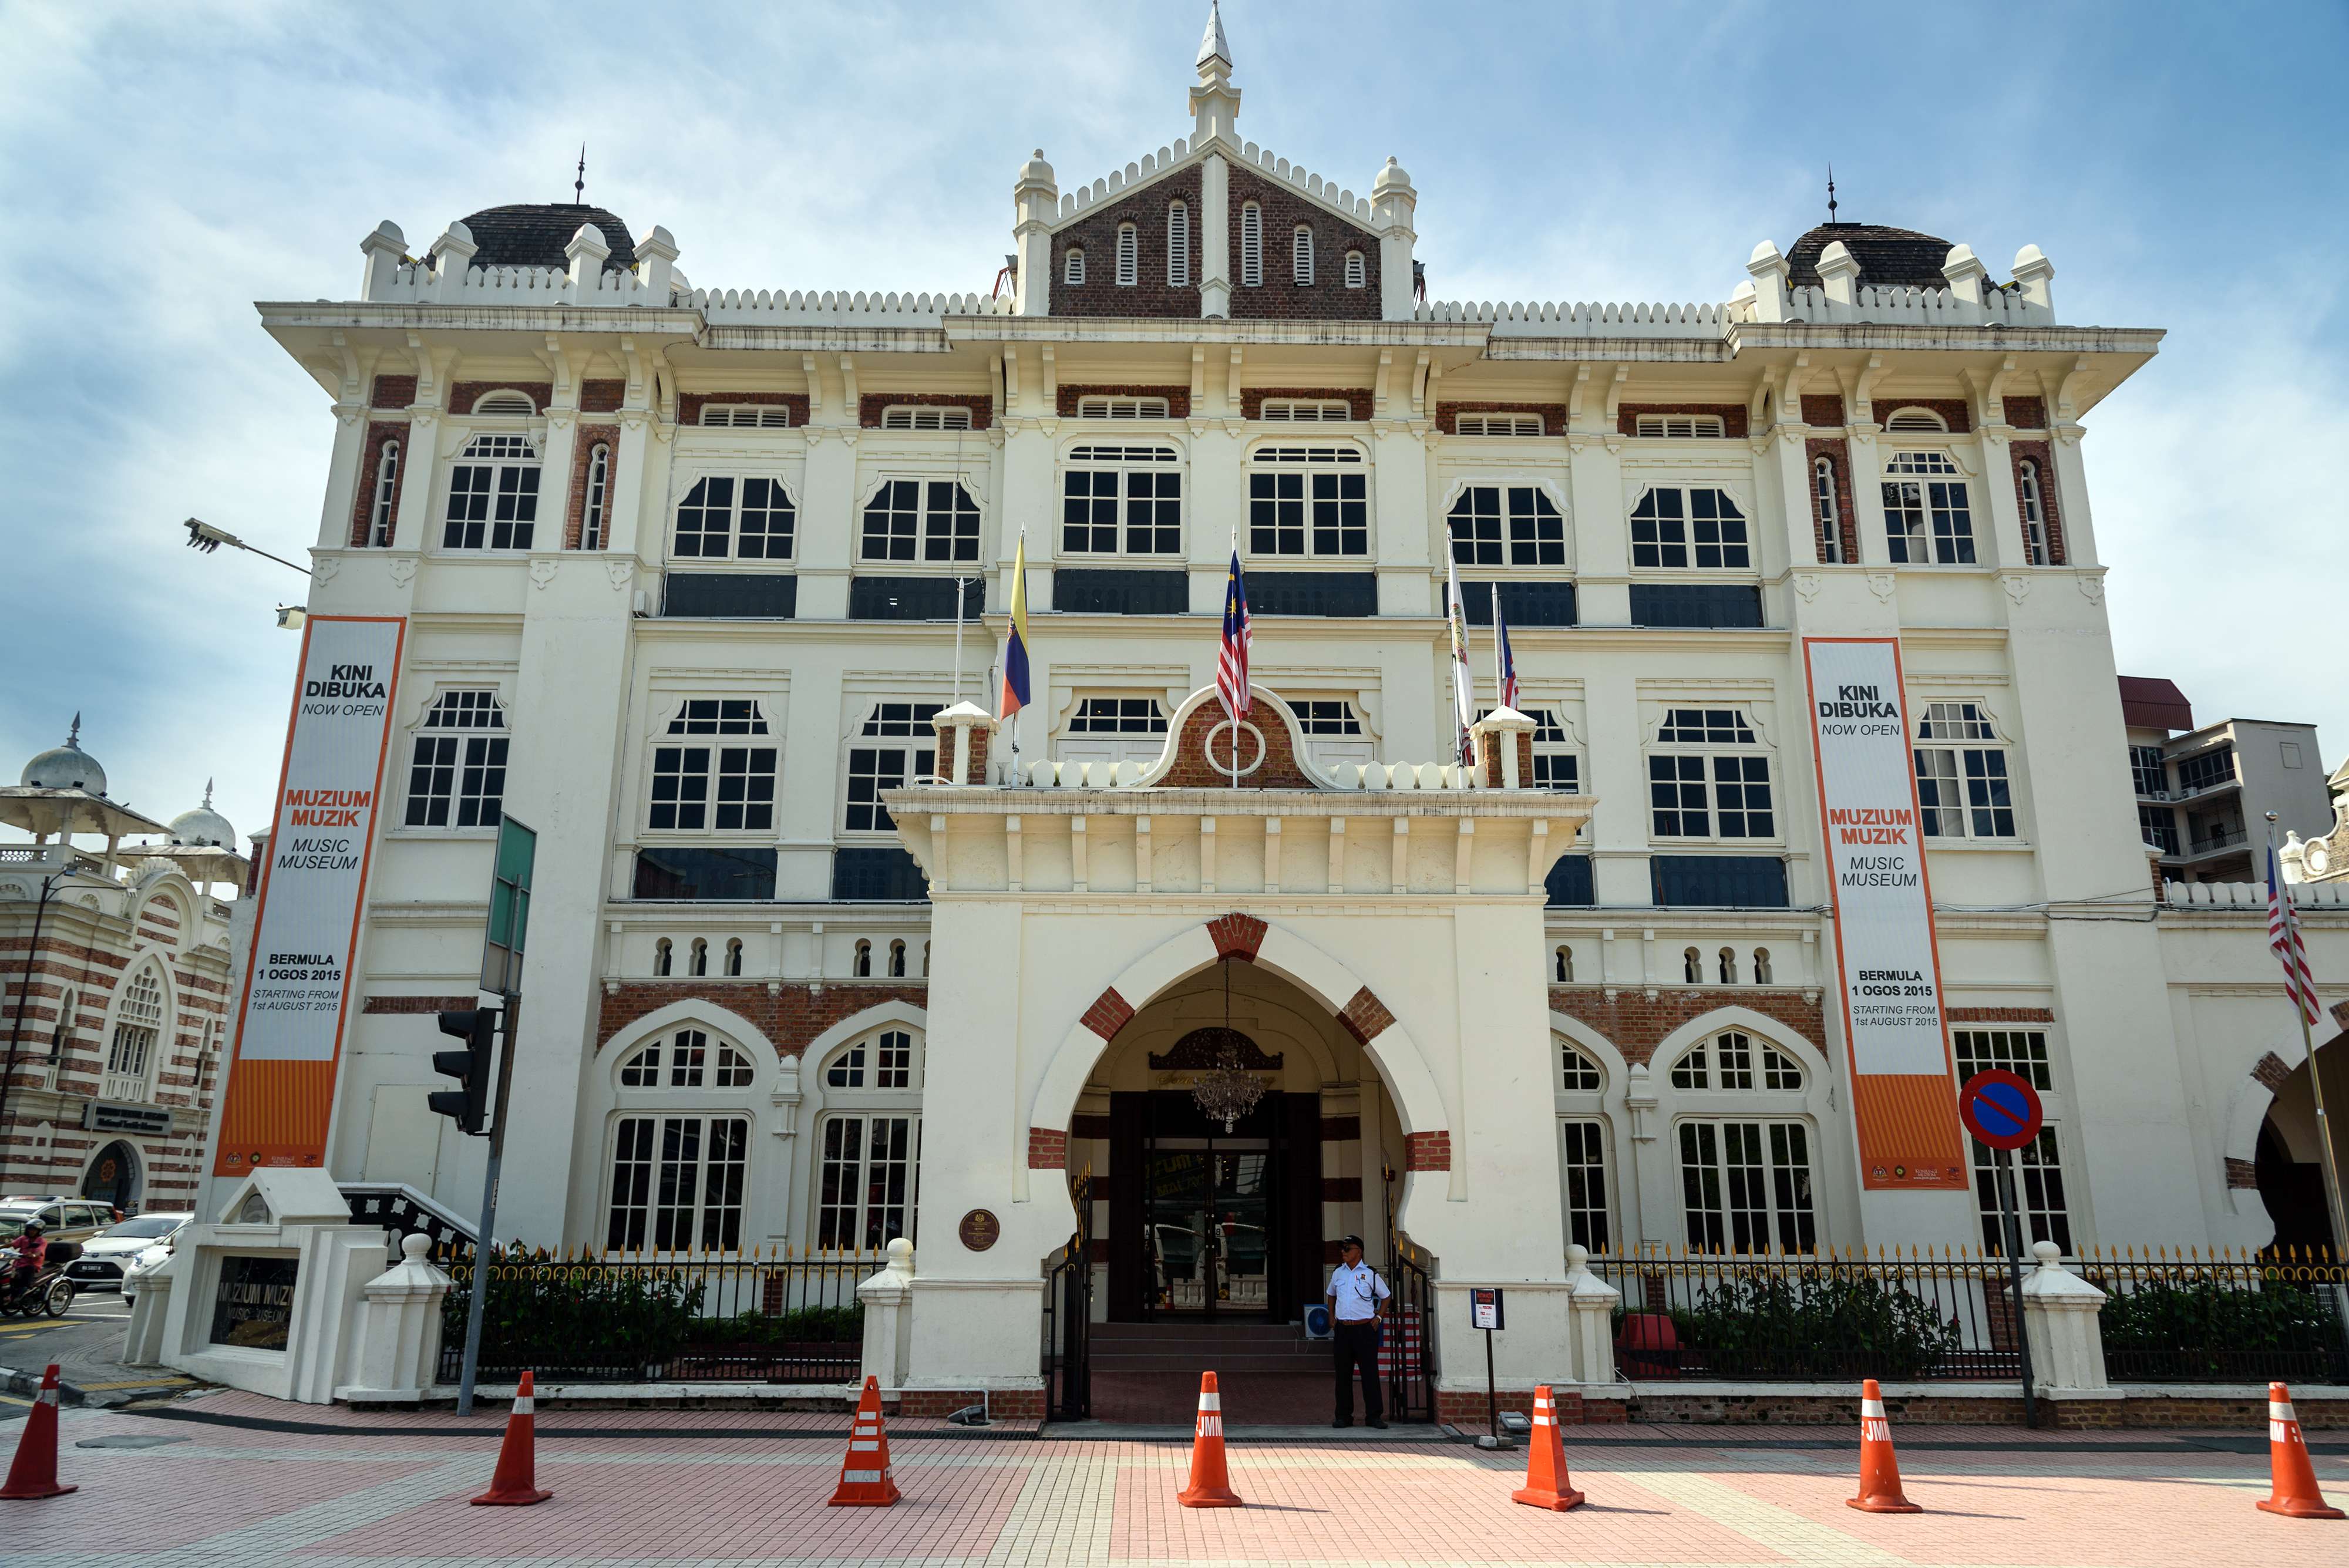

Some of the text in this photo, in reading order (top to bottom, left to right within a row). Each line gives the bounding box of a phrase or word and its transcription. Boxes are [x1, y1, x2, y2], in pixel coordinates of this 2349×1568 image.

[331, 665, 372, 681] KINI
[306, 681, 385, 698] DIBUKA
[1839, 685, 1879, 701] KINI
[302, 704, 384, 716] NOW OPEN
[1819, 702, 1898, 718] DIBUKA
[1822, 725, 1899, 735] NOW OPEN
[286, 789, 371, 807] MUZIUM
[291, 809, 360, 826] MUZIK
[1830, 809, 1913, 826] MUZIUM
[1840, 829, 1907, 844] MUZIK
[292, 839, 349, 852] MUSIC
[278, 855, 358, 869] MUSEUM
[1851, 857, 1904, 870] MUSIC
[1842, 873, 1916, 886] MUSEUM
[270, 954, 334, 965] BERMULA
[259, 969, 341, 980] 1 OGOS 2015
[1859, 971, 1923, 981] BERMULA
[253, 990, 339, 999] STARTING FROM
[1852, 985, 1932, 996] 1 OGOS 2015
[267, 1002, 312, 1010] AUGUST
[314, 1002, 338, 1011] 2015
[1906, 1006, 1935, 1014] FROM
[1870, 1017, 1912, 1025] AUGUST
[1916, 1018, 1937, 1026] 2015
[219, 1283, 261, 1303] MUZIUM
[254, 1308, 287, 1323] USEUM
[1199, 1416, 1223, 1438] JMM
